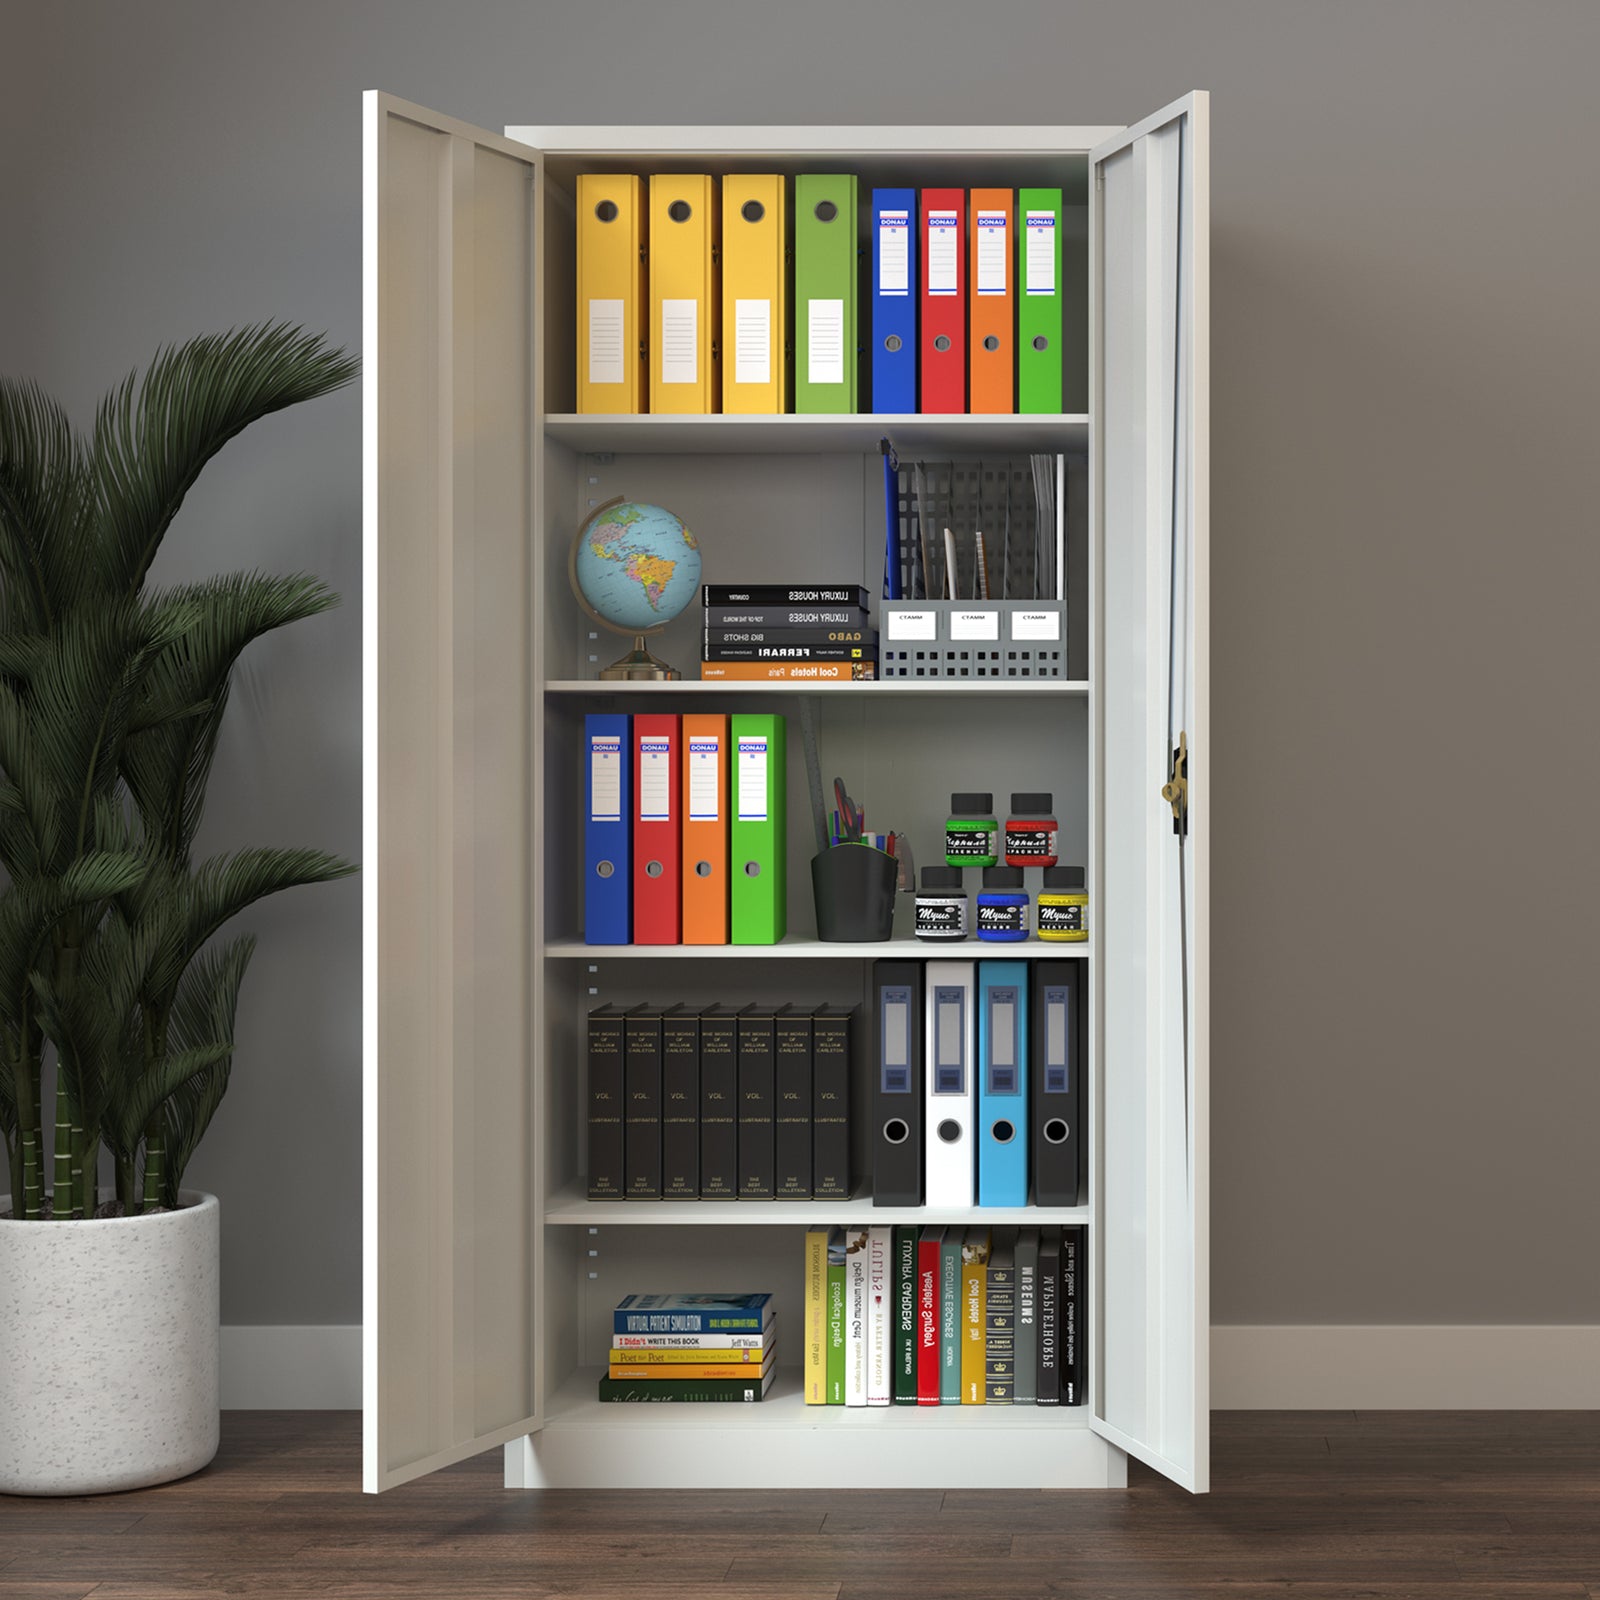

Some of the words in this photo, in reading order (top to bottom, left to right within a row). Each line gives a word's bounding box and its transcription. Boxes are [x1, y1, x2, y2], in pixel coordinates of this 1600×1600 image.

[627, 1315, 649, 1331] VIRTUAL
[650, 1315, 670, 1331] PATIENT
[671, 1315, 702, 1331] SIMULATION
[624, 1337, 646, 1346] Didn't
[731, 1338, 741, 1348] Jeff
[743, 1339, 759, 1347] Watts
[648, 1353, 664, 1362] Poet
